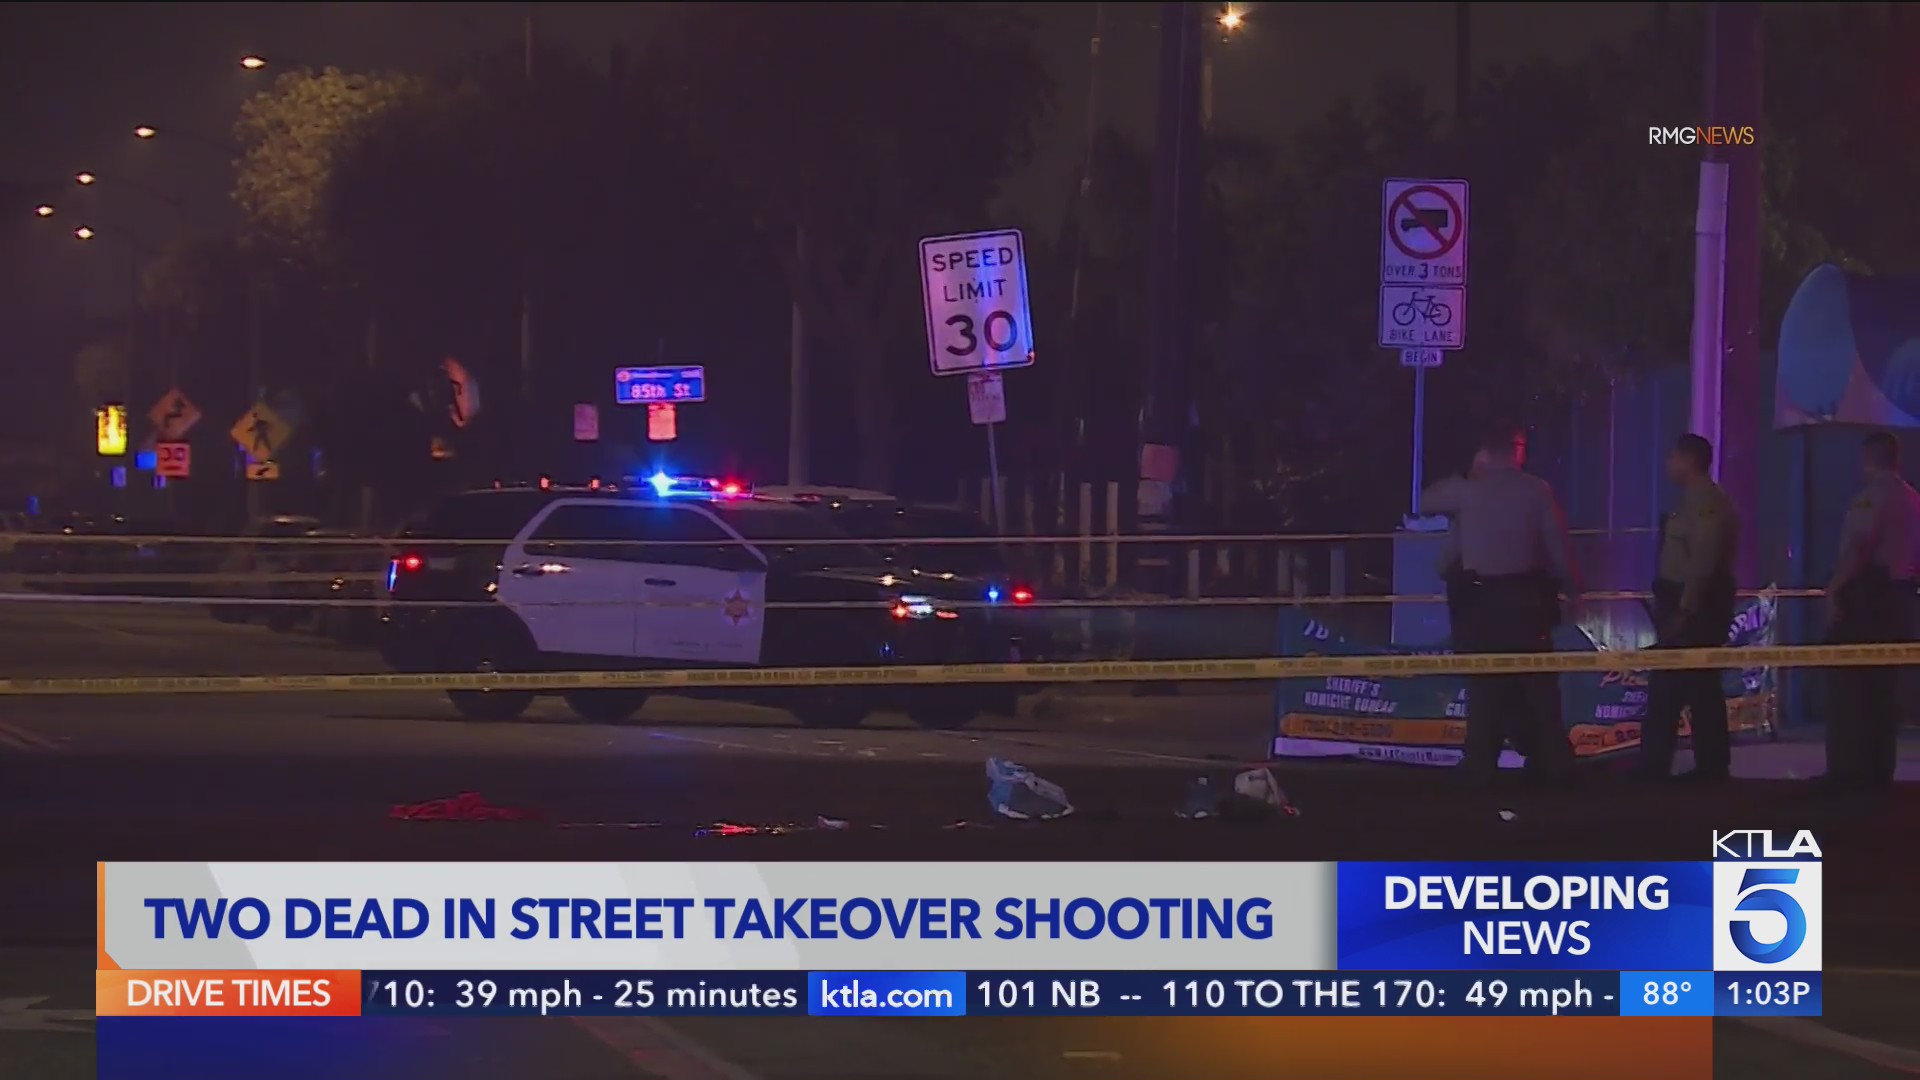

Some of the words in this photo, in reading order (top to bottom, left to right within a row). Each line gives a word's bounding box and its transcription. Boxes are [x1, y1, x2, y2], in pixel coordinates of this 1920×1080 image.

[932, 247, 1014, 272] SPEED
[1386, 264, 1416, 277] OVER
[1419, 263, 1429, 280] 3
[1433, 265, 1462, 278] TONS
[943, 279, 1008, 302] LIMIT
[945, 309, 1018, 357] 30
[1389, 329, 1416, 341] BIKE
[1424, 330, 1455, 342] LANE
[1404, 350, 1438, 363] BEGIN
[1325, 676, 1381, 698] SHERIFF'S
